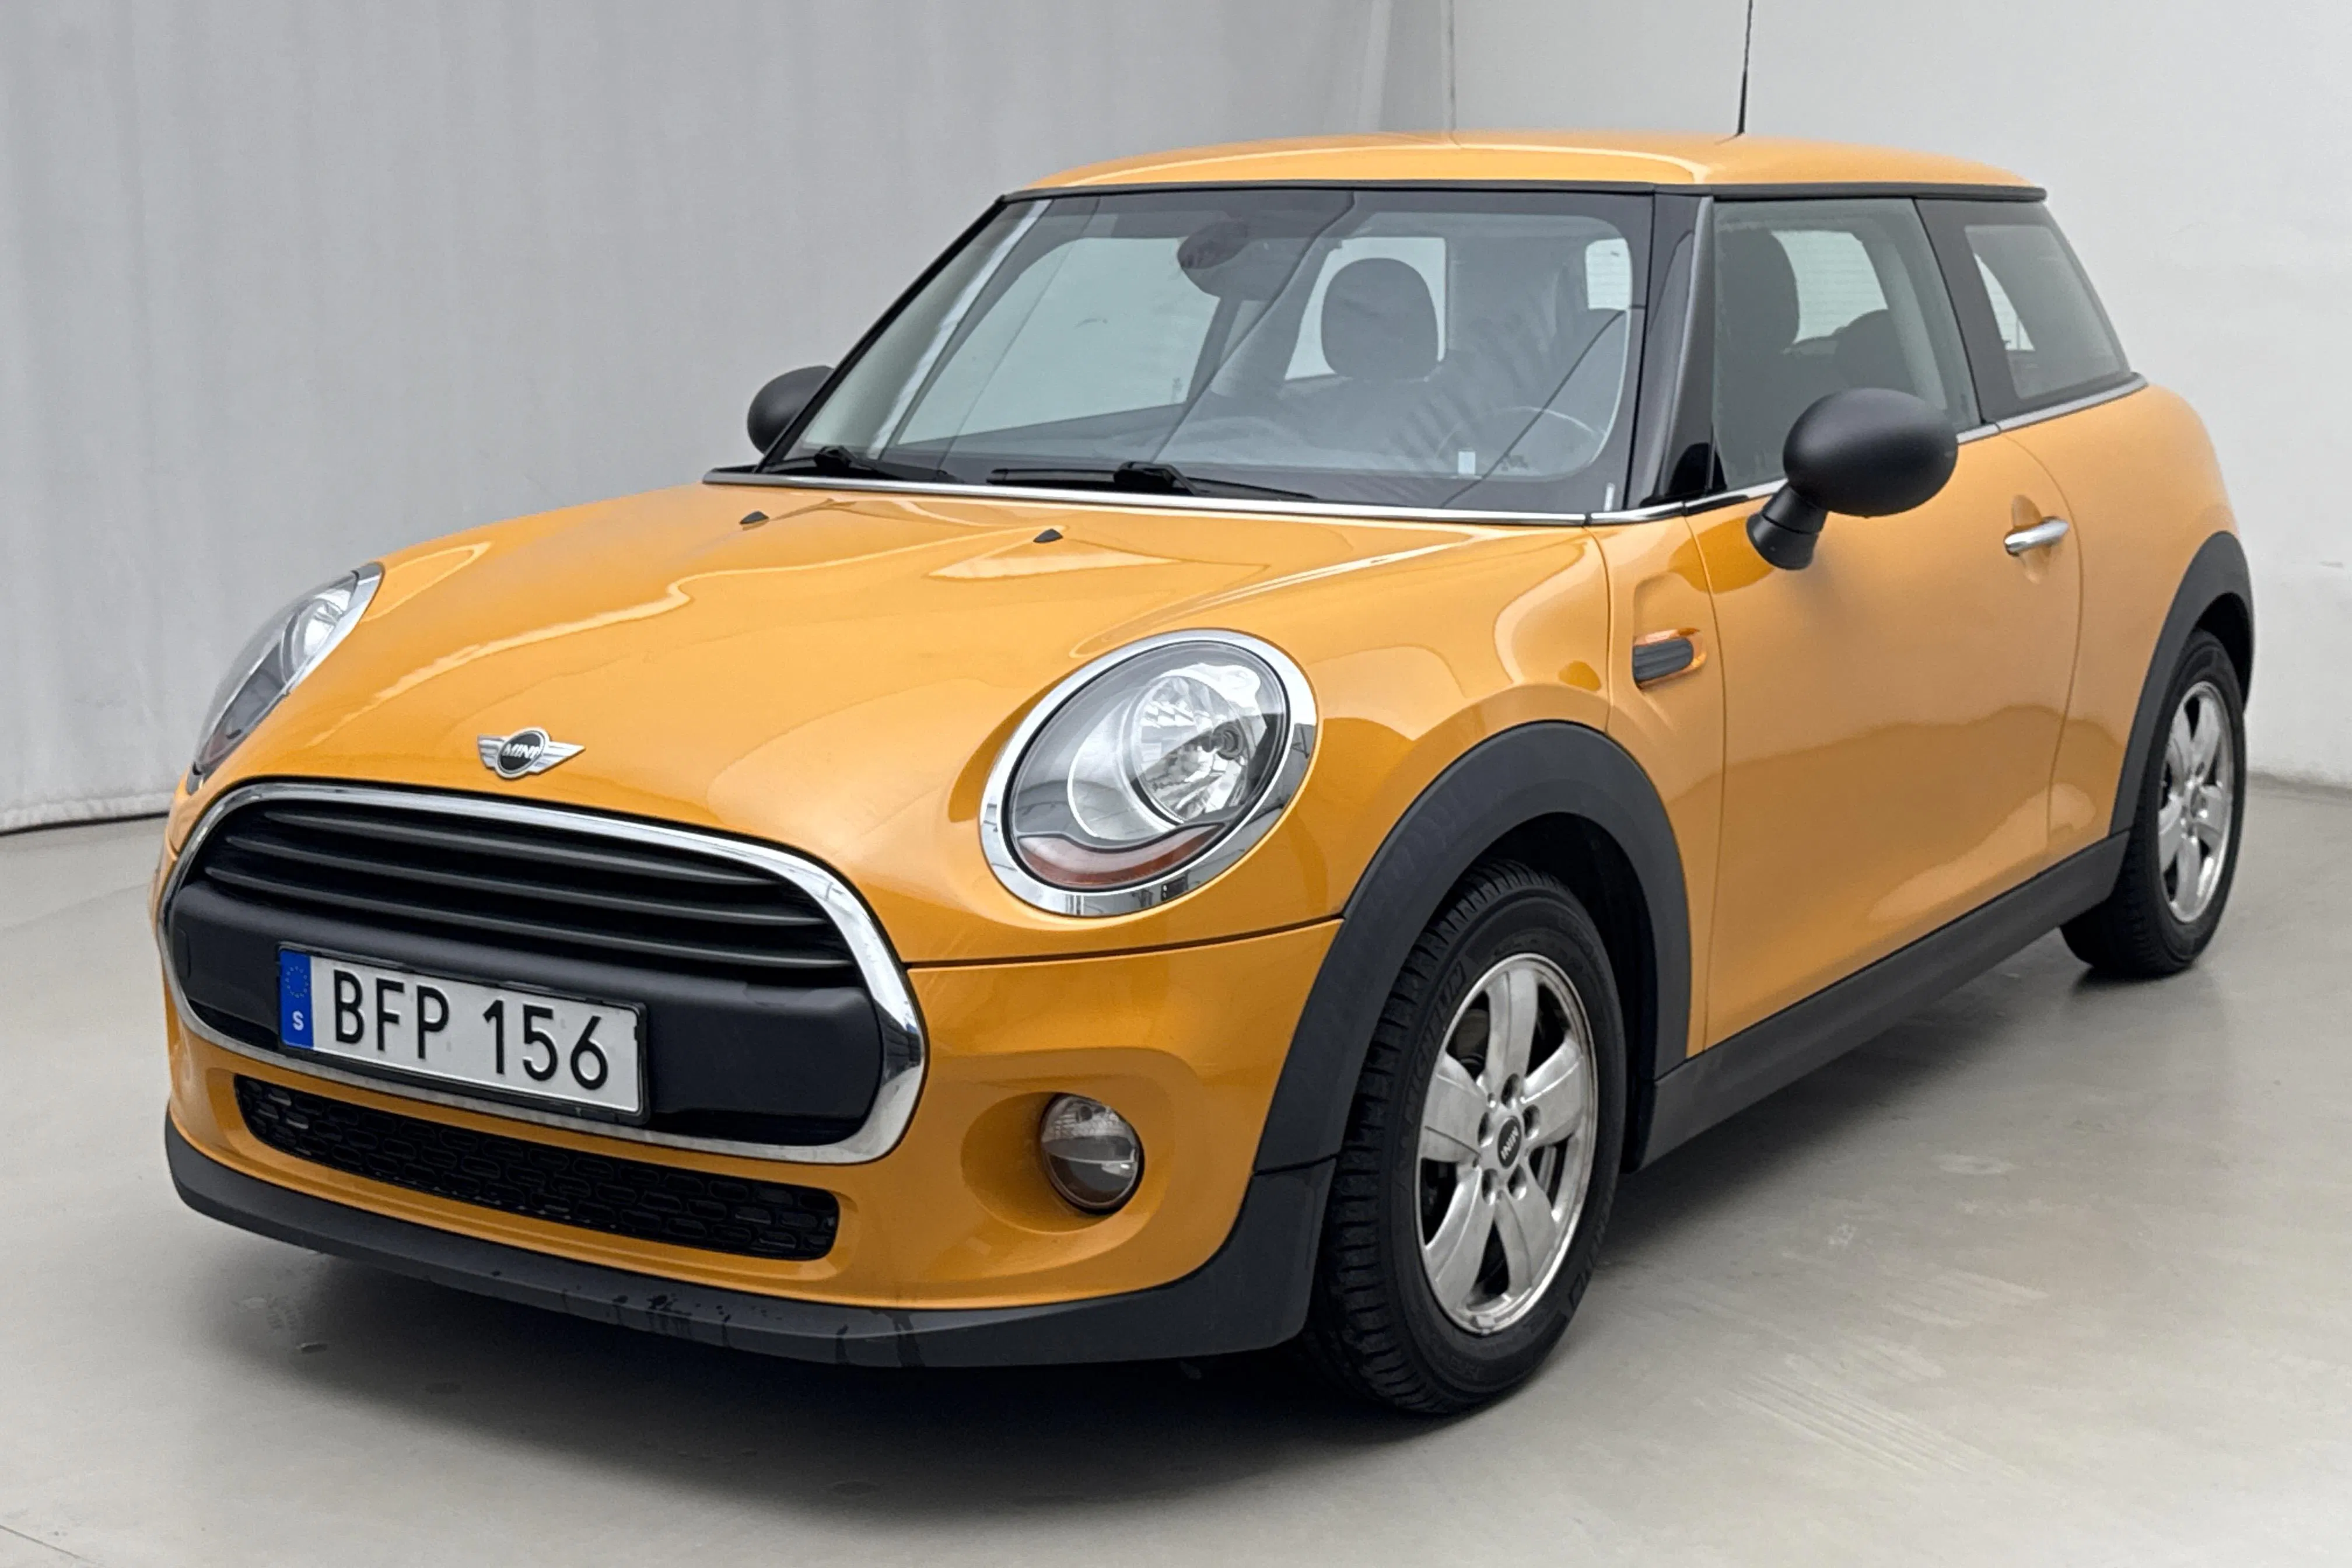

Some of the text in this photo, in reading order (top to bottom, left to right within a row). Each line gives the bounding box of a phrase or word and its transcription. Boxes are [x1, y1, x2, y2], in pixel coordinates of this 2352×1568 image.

[502, 743, 542, 759] MINI
[292, 1011, 304, 1031] S
[334, 969, 608, 1090] BFP 156
[1500, 1126, 1518, 1161] MINI
